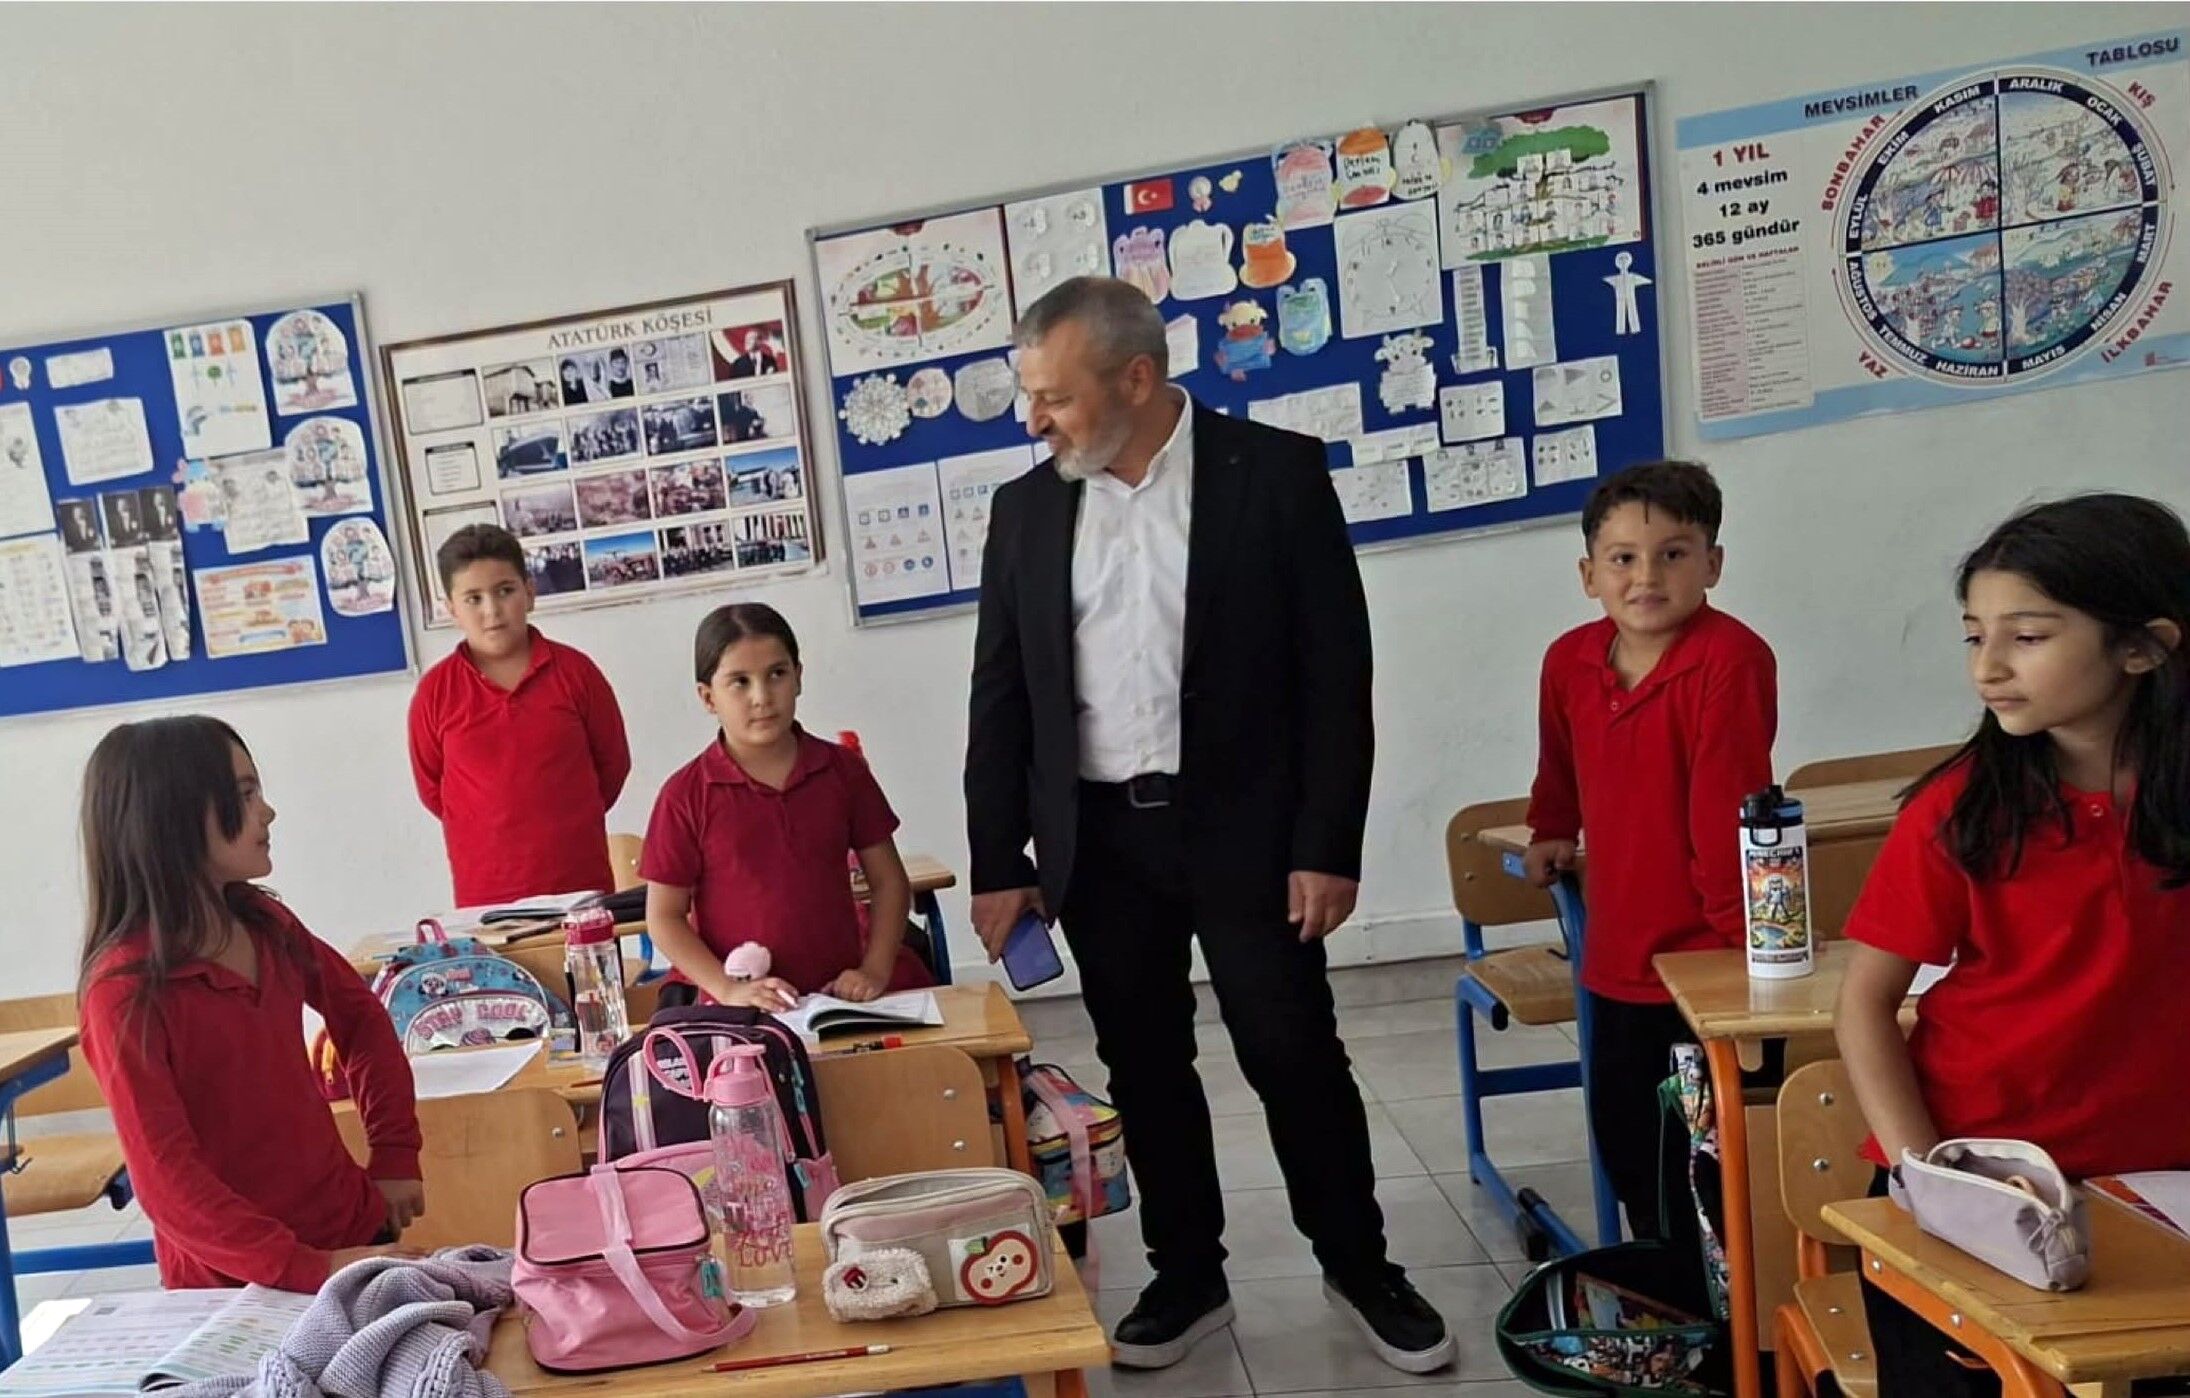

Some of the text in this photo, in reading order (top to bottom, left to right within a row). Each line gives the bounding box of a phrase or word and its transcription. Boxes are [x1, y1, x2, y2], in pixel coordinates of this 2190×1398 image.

[1804, 37, 2180, 118] MEVSİMLER TABLOSU
[2008, 78, 2064, 94] ARALIK
[1934, 85, 1982, 114] KASIM
[2128, 81, 2157, 109] KIŞ
[2086, 96, 2124, 127] OCAK
[1713, 142, 1770, 167] 1 YIL
[1821, 113, 1887, 211] SONBAHAR
[1877, 131, 1910, 166] EKİM
[2132, 142, 2157, 186] ŞUBAT
[1697, 169, 1788, 195] 4 mevsim
[1719, 199, 1770, 218] 12 ay
[1692, 219, 1800, 249] 365 gündür
[2136, 224, 2156, 264] MART
[1848, 261, 1878, 321] AĞUSTOS
[2090, 292, 2127, 331] NİSAN
[2101, 281, 2173, 363] İLKBAHAR
[549, 305, 712, 349] ATATÜRK KÖŞESİ
[1878, 324, 1929, 364] TEMMUZ
[2022, 345, 2066, 370] MAYIS
[1858, 350, 1890, 378] YAZ
[1935, 359, 2000, 376] HAZİRAN
[476, 1003, 530, 1021] COOL
